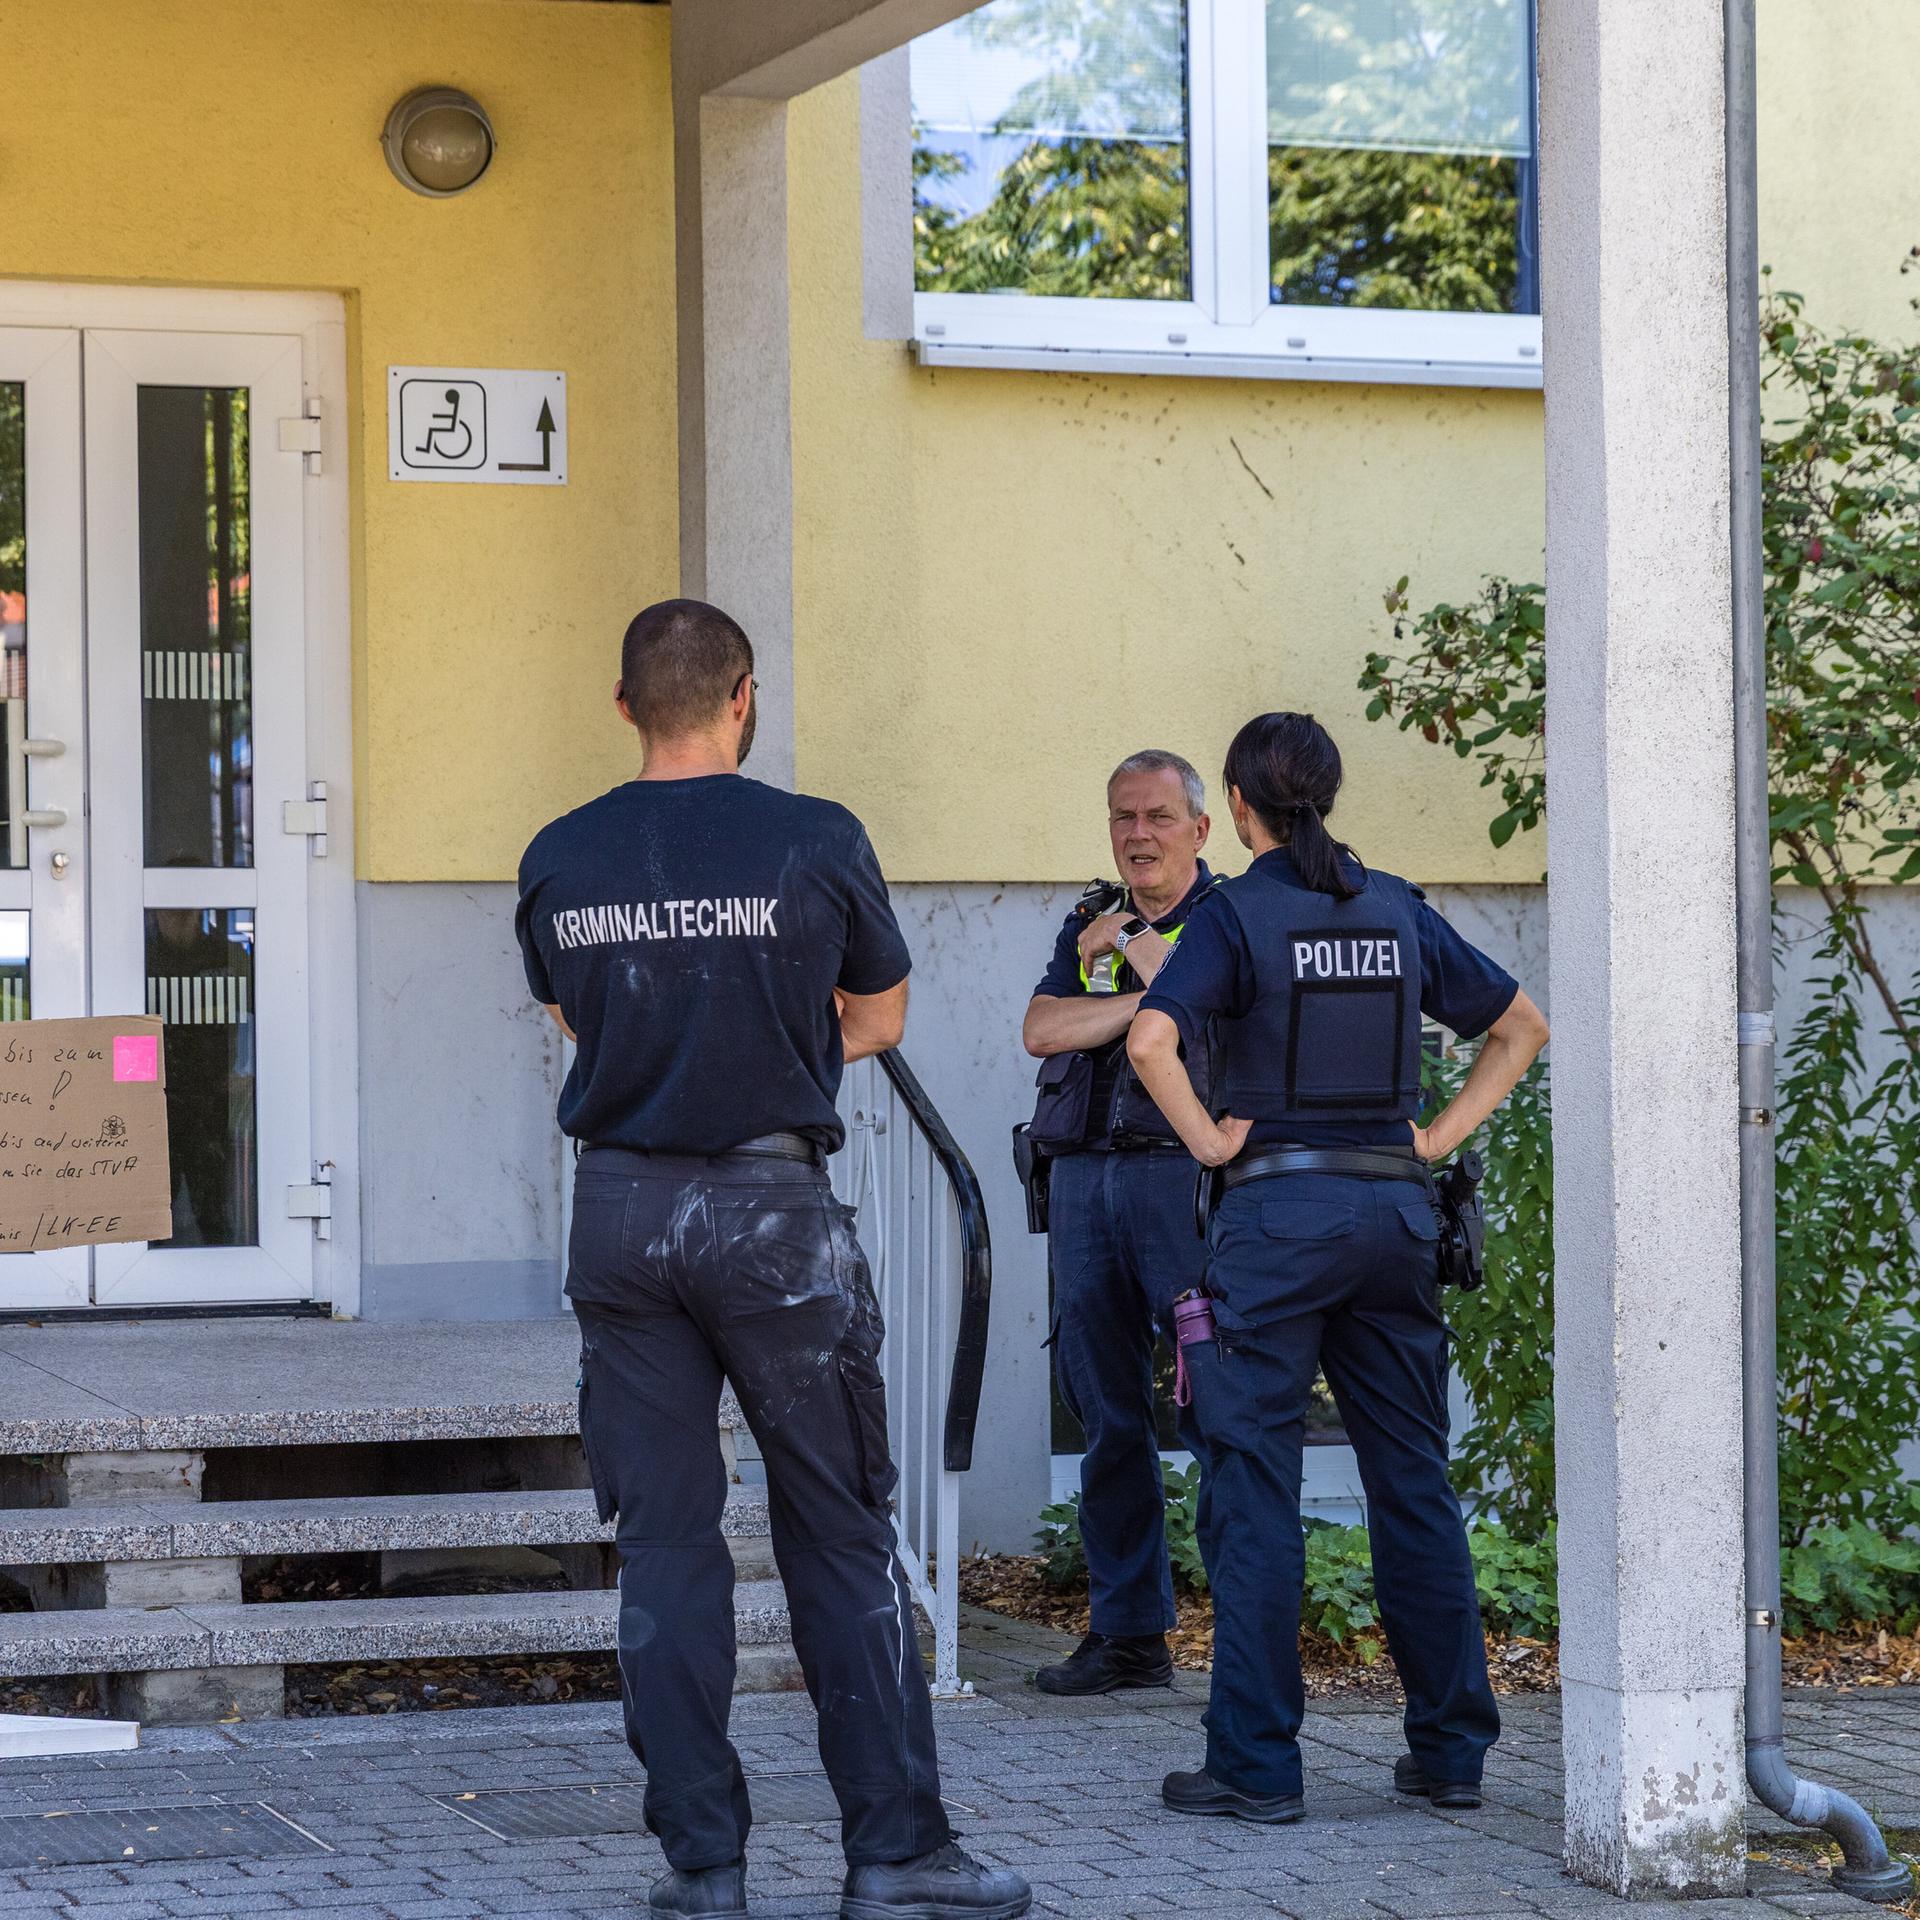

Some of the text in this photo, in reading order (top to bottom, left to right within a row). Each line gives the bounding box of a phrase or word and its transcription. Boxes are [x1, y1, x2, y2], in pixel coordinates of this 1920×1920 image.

[553, 898, 778, 949] KRIMINALTECHNIK
[1294, 940, 1401, 978] POLIZEI
[4, 1038, 33, 1063] bis
[0, 1131, 23, 1149] bis
[22, 1163, 42, 1177] Sie
[56, 1161, 83, 1178] das
